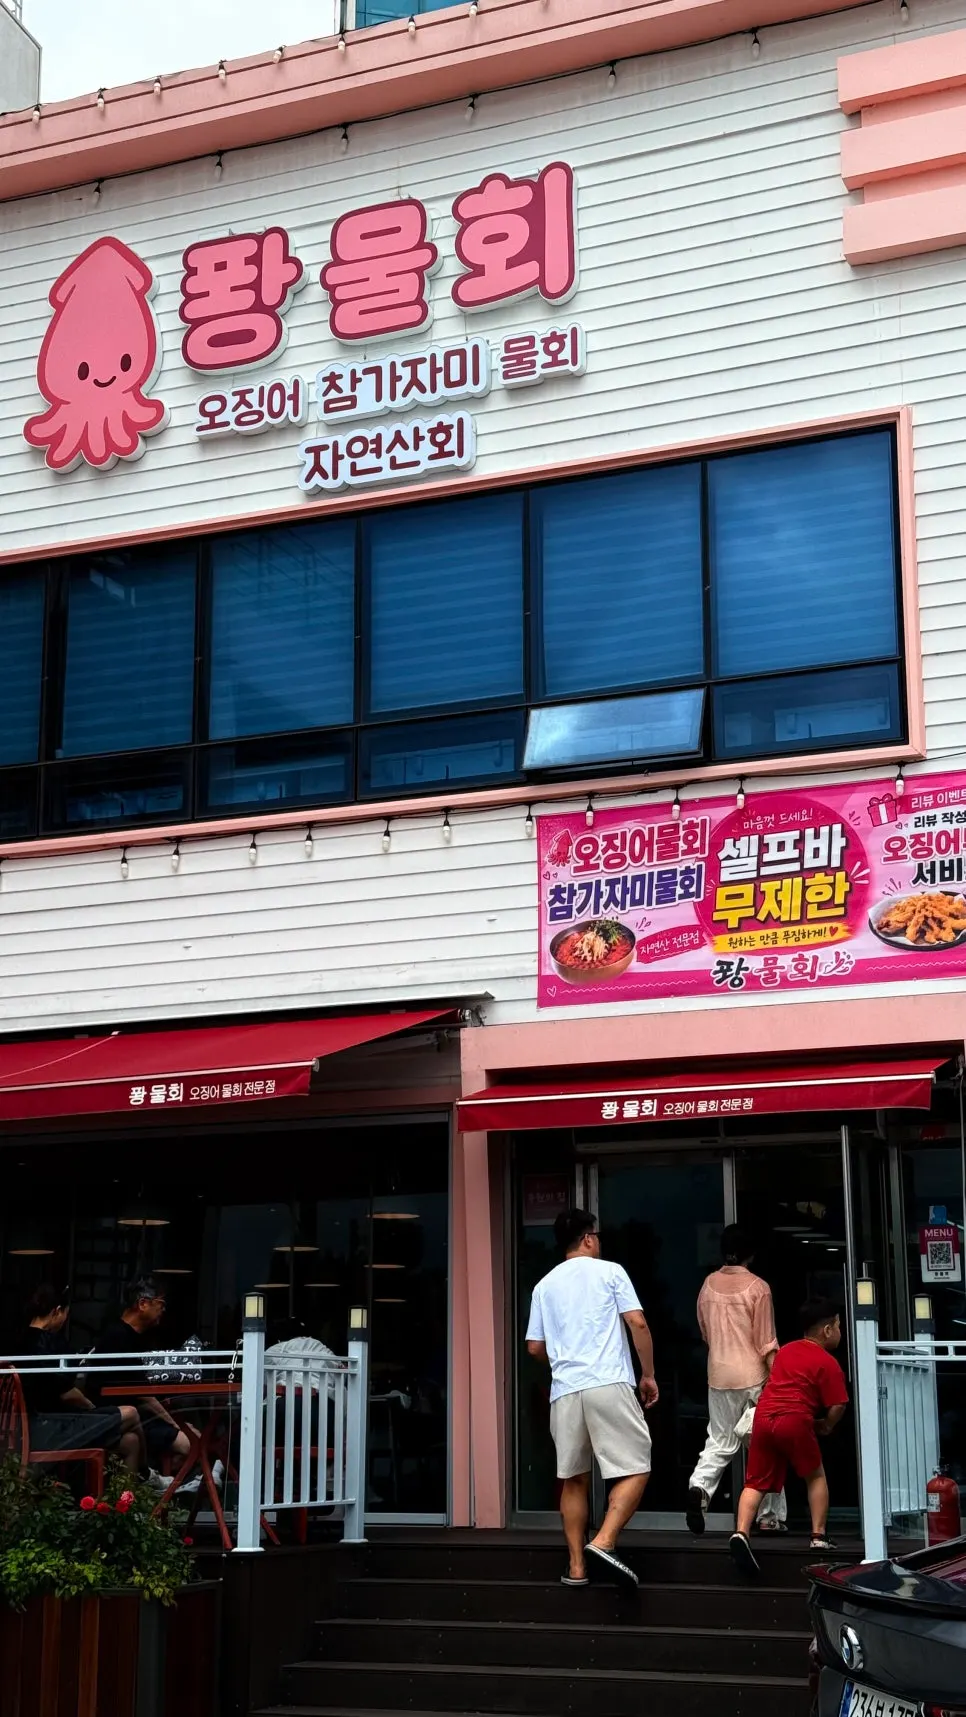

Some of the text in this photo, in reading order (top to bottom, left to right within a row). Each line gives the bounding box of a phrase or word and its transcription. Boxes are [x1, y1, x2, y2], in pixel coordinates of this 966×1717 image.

[196, 326, 578, 432] 오징어 참가자미 물회
[304, 416, 465, 484] 자연산회
[911, 794, 934, 809] 리뷰
[743, 807, 814, 830] 마음껏 드세요!
[914, 813, 938, 828] 리뷰
[572, 818, 708, 875] 오징어물회
[717, 823, 847, 882] 셀프바
[882, 827, 966, 863] 오징어
[911, 857, 966, 885] 서비
[547, 863, 703, 922] 참가자미물회
[712, 871, 850, 929] 무제한
[640, 938, 670, 954] 자연산
[671, 929, 699, 948] 전문점
[728, 926, 827, 949] 원하는 만큼 푸짐하게!
[924, 1228, 953, 1238] MENU
